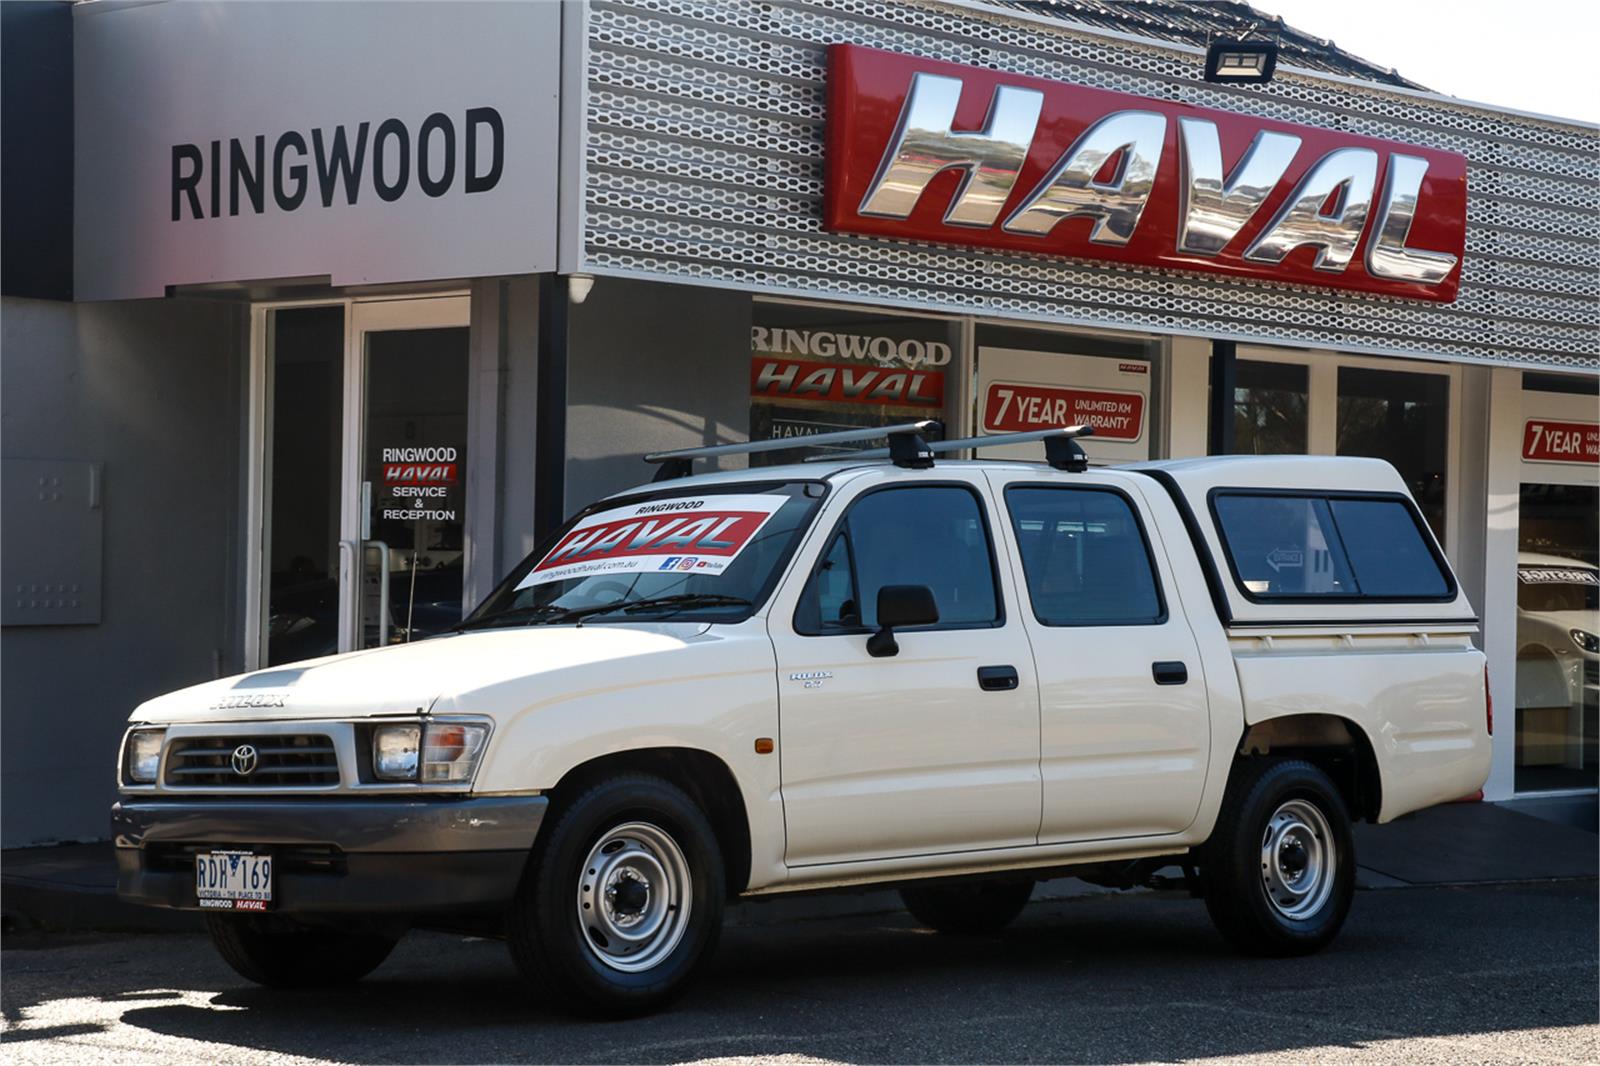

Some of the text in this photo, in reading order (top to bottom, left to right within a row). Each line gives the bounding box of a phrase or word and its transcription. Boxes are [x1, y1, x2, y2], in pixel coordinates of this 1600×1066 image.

[171, 106, 505, 221] RINGWOOD
[857, 72, 1458, 284] HAVAL
[752, 326, 952, 366] RINGWOOD
[755, 363, 937, 403] HAVAL
[993, 389, 1067, 426] 7 YEAR
[1075, 400, 1132, 414] UNLIMITED KM
[1528, 425, 1581, 455] 7 YEAR
[383, 447, 457, 462] RINGWOOD
[1585, 444, 1600, 456] WA
[386, 466, 456, 481] HAVAL
[392, 486, 447, 497] SERVICE
[414, 498, 424, 509] &
[635, 500, 704, 515] RINGWOOD
[383, 510, 455, 521] RECEPTION
[547, 516, 742, 564] HAVAL
[198, 858, 271, 890] RDH 169
[200, 899, 265, 909] RINGWOOD HAVAL
